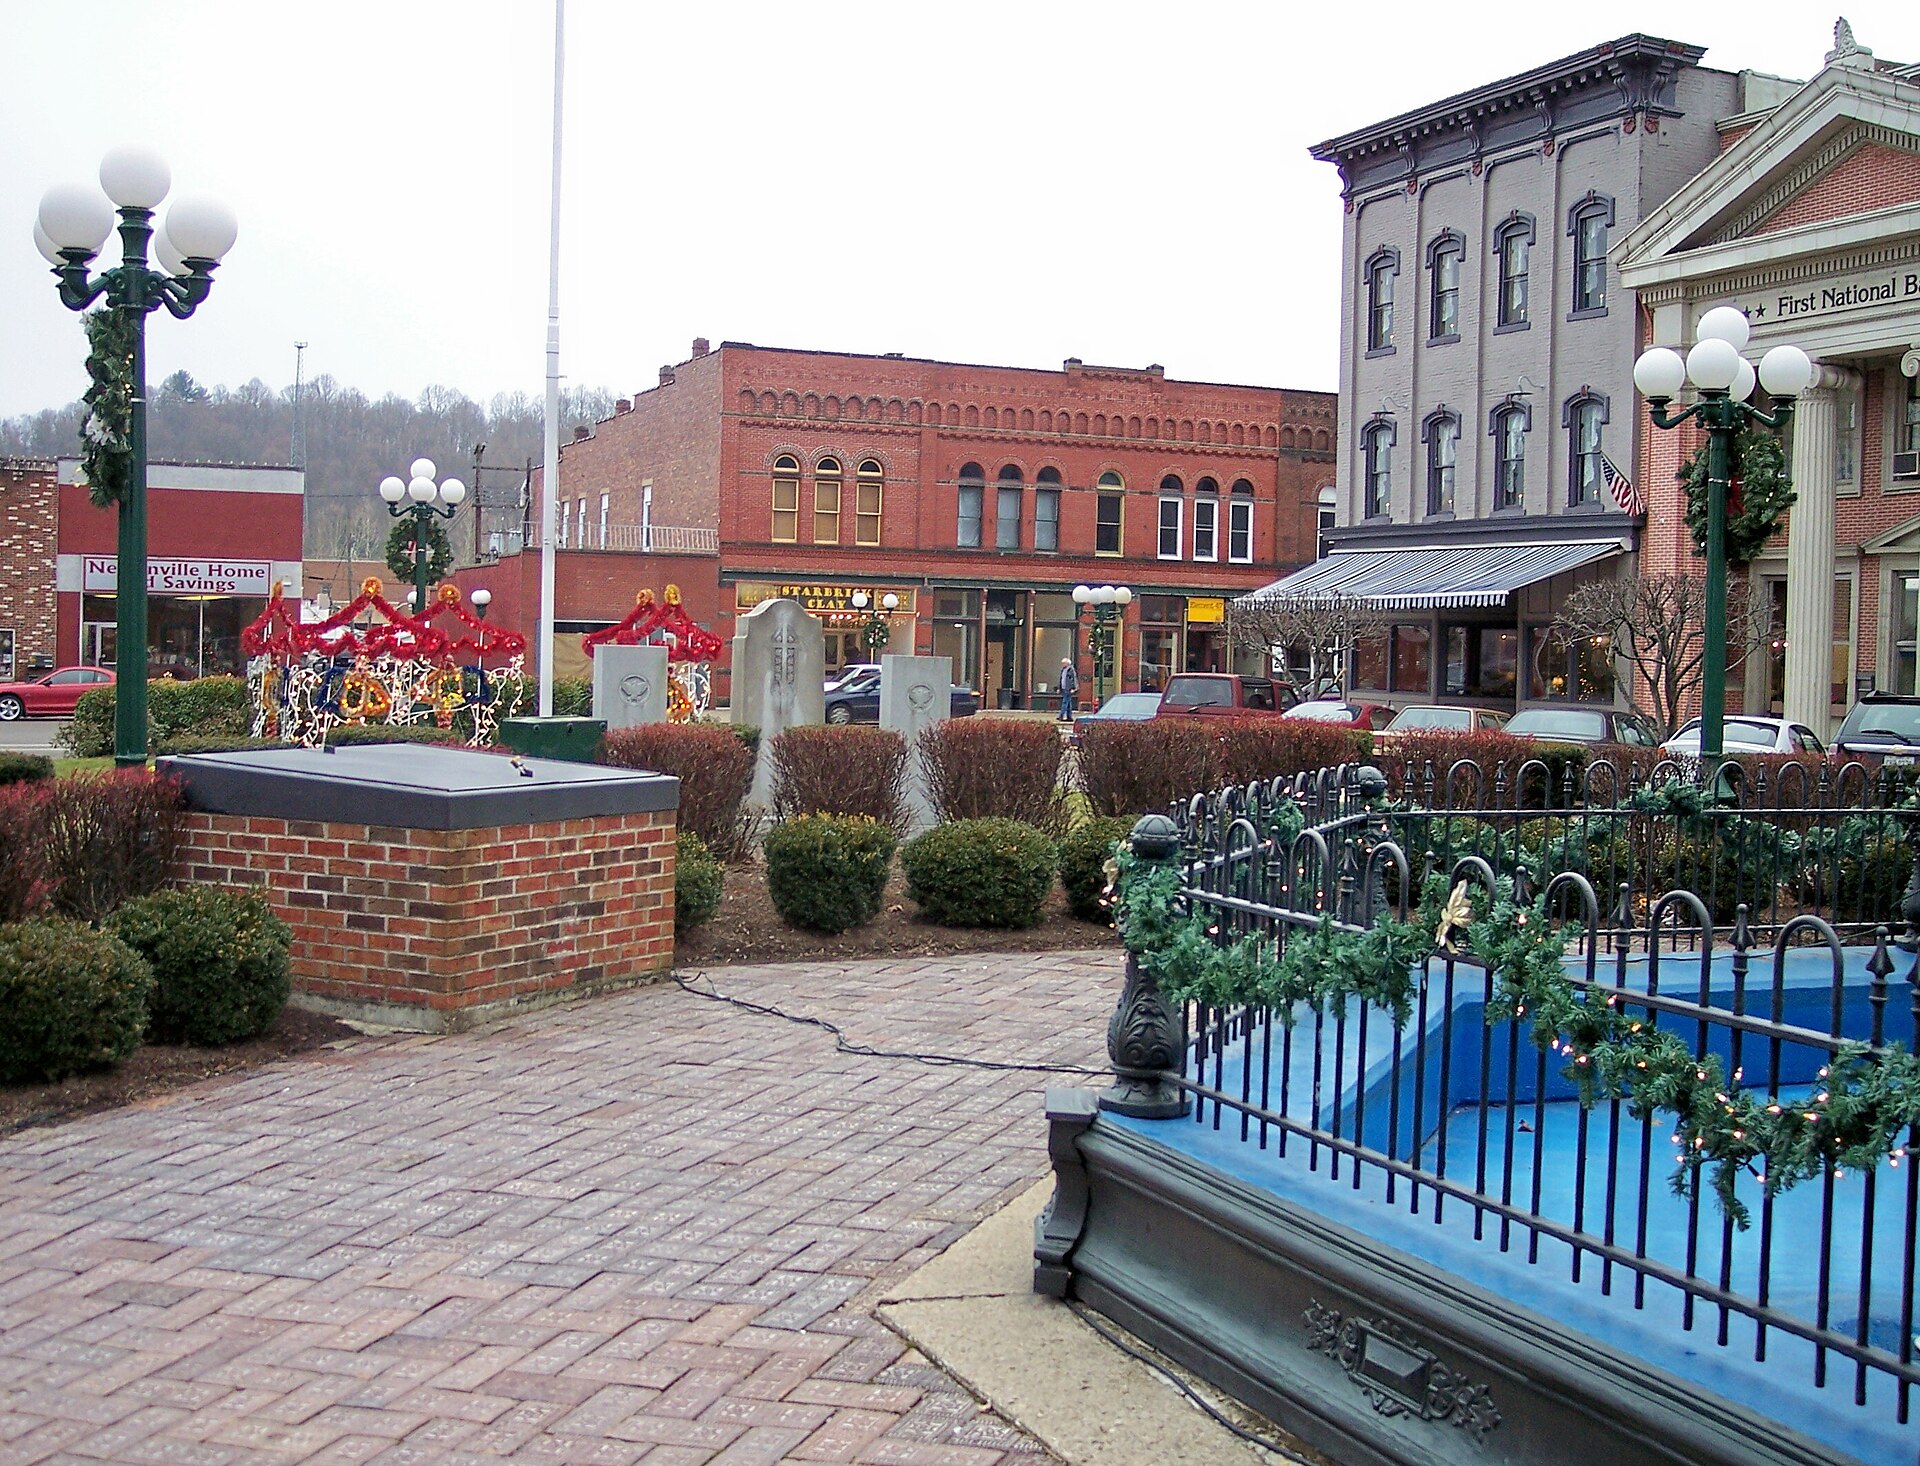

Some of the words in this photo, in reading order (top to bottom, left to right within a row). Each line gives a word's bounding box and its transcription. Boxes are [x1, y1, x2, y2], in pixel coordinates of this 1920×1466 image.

[1777, 292, 1816, 317] First
[1822, 278, 1896, 309] National
[1904, 274, 1920, 296] B
[89, 560, 199, 577] Nenville
[208, 564, 265, 578] Home
[163, 576, 236, 592] Savings
[807, 598, 847, 609] CLAY
